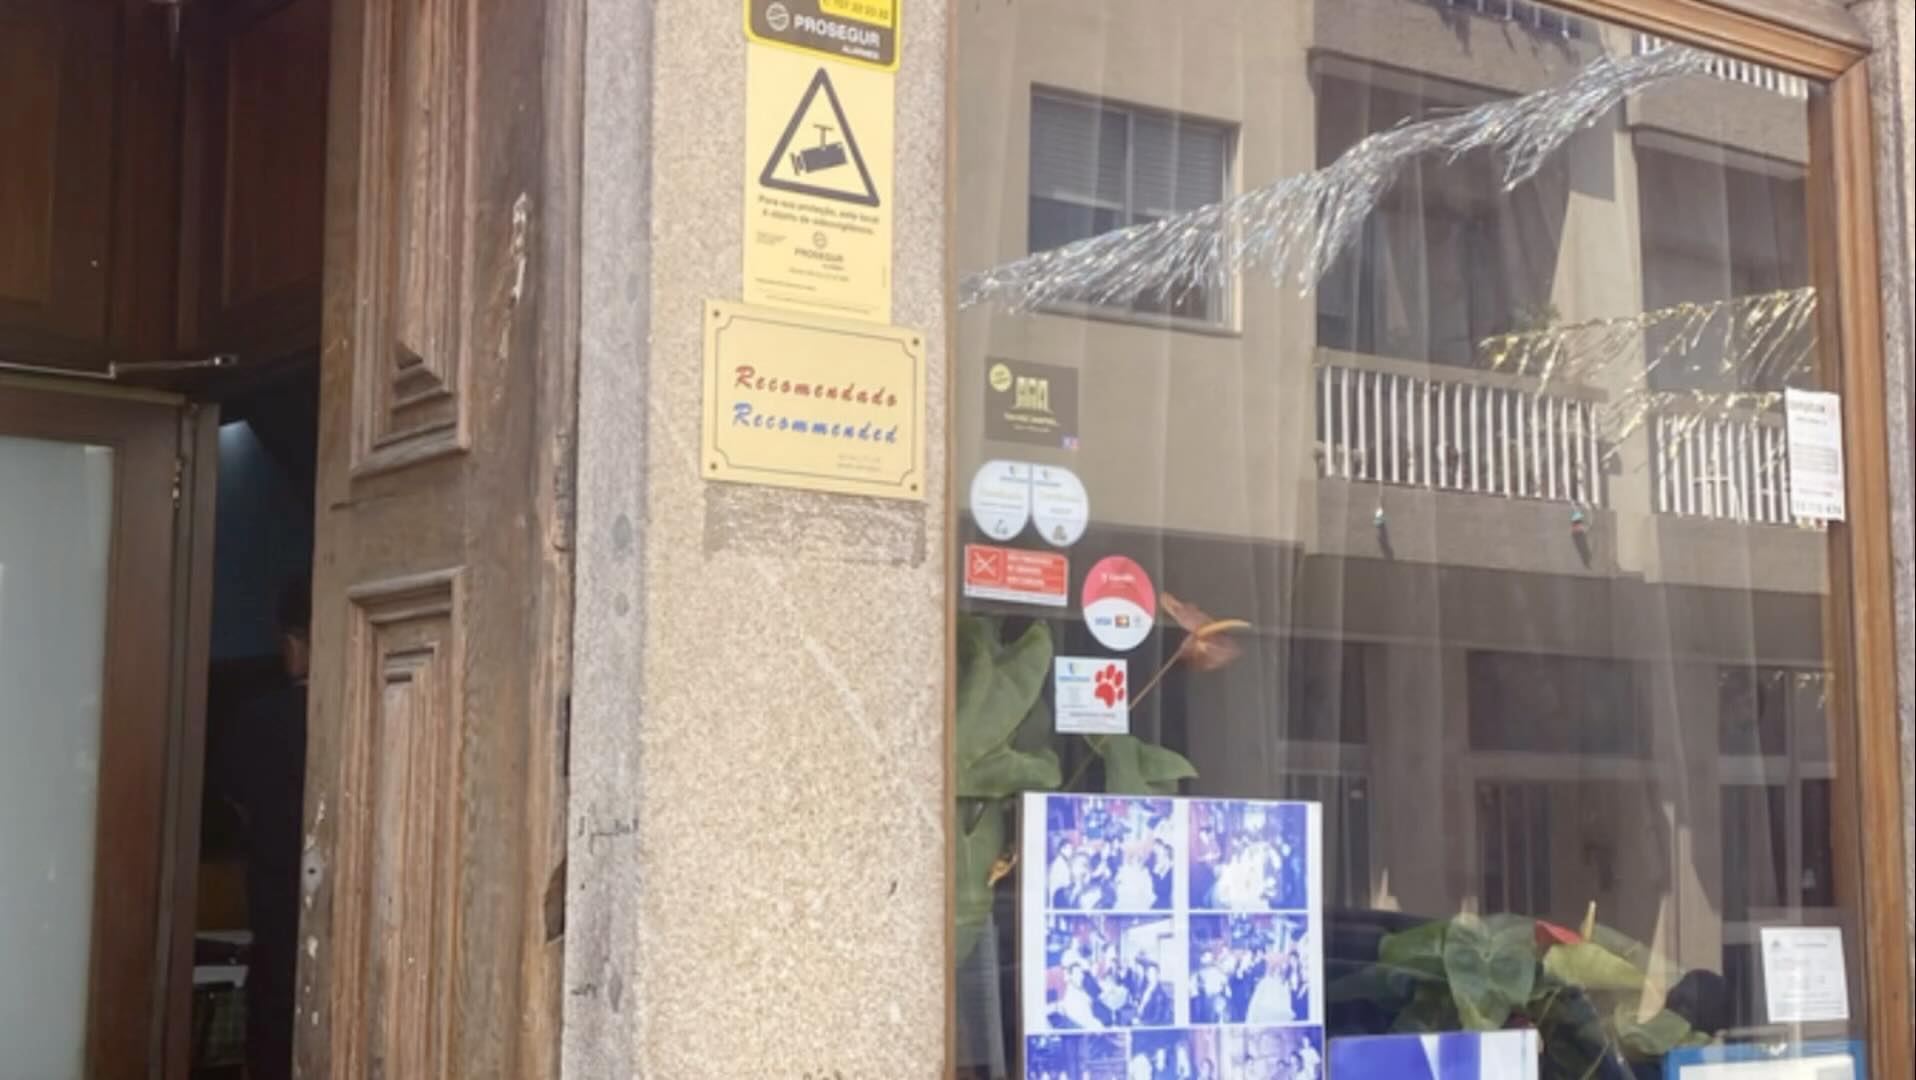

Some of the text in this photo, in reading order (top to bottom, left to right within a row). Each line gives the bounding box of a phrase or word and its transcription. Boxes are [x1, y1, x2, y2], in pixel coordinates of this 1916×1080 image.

[794, 14, 880, 47] PROSEGUR
[794, 247, 844, 263] PROSEGUR
[734, 364, 898, 407] Recomendado
[732, 402, 898, 444] Recommended
